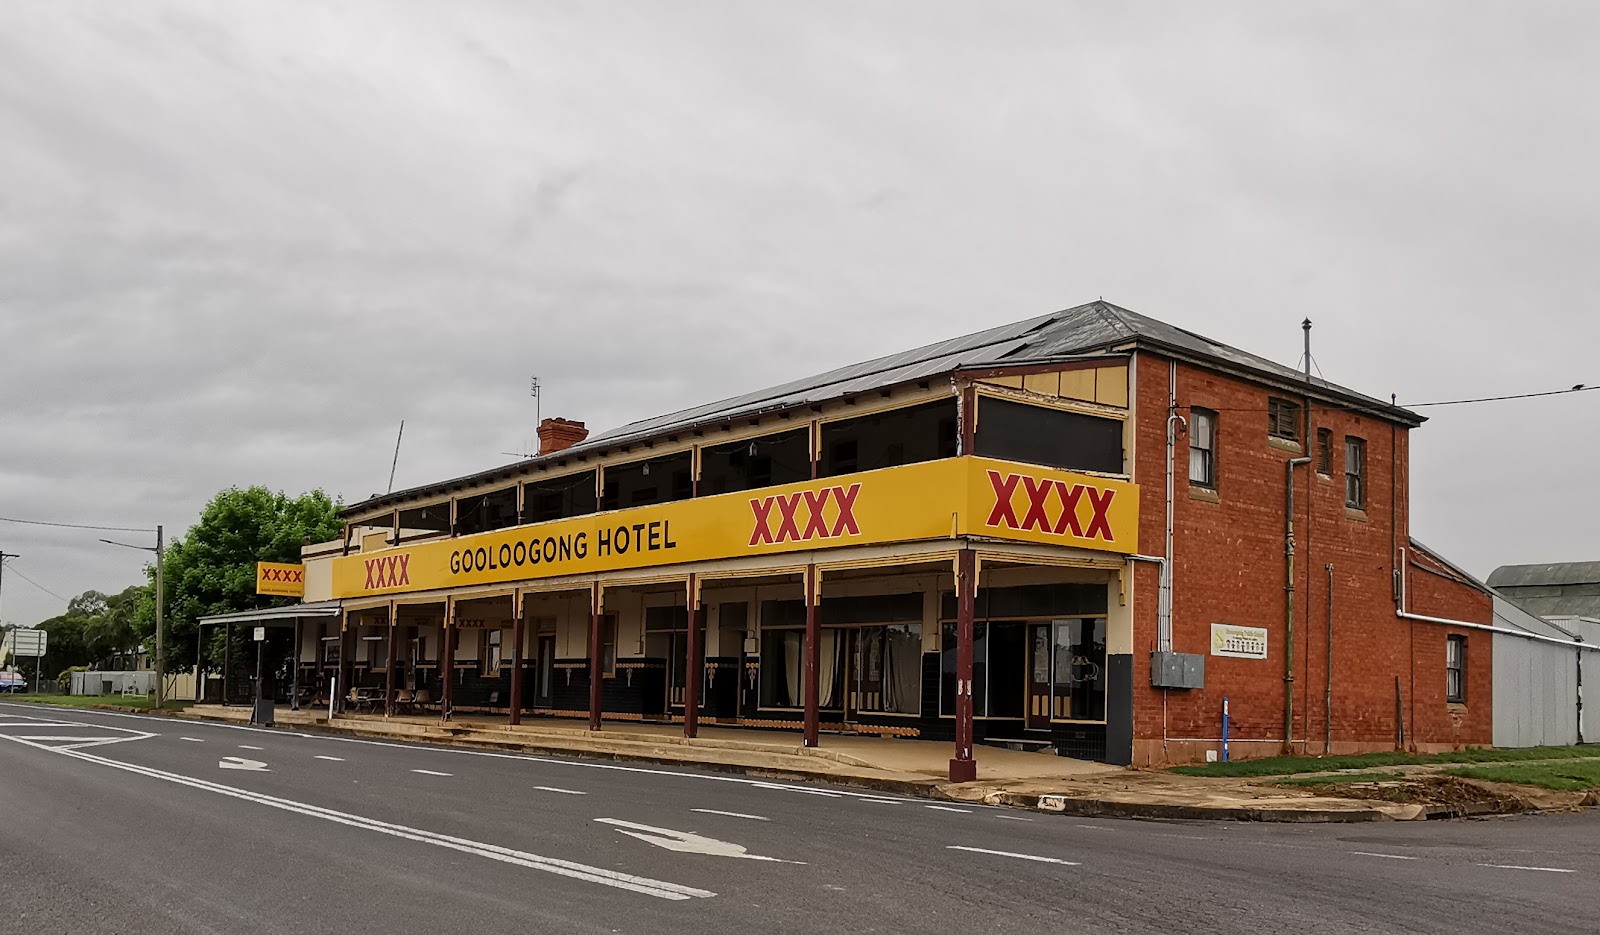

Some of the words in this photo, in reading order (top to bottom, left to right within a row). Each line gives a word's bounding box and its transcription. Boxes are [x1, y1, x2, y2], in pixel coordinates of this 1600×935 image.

[748, 483, 862, 547] XXXX
[985, 469, 1117, 543] XXXX
[450, 532, 587, 574] GOOLOOGONG
[598, 520, 677, 557] HOTEL
[261, 568, 303, 583] XXXX
[364, 553, 411, 590] XXXX
[458, 618, 485, 628] XXXX
